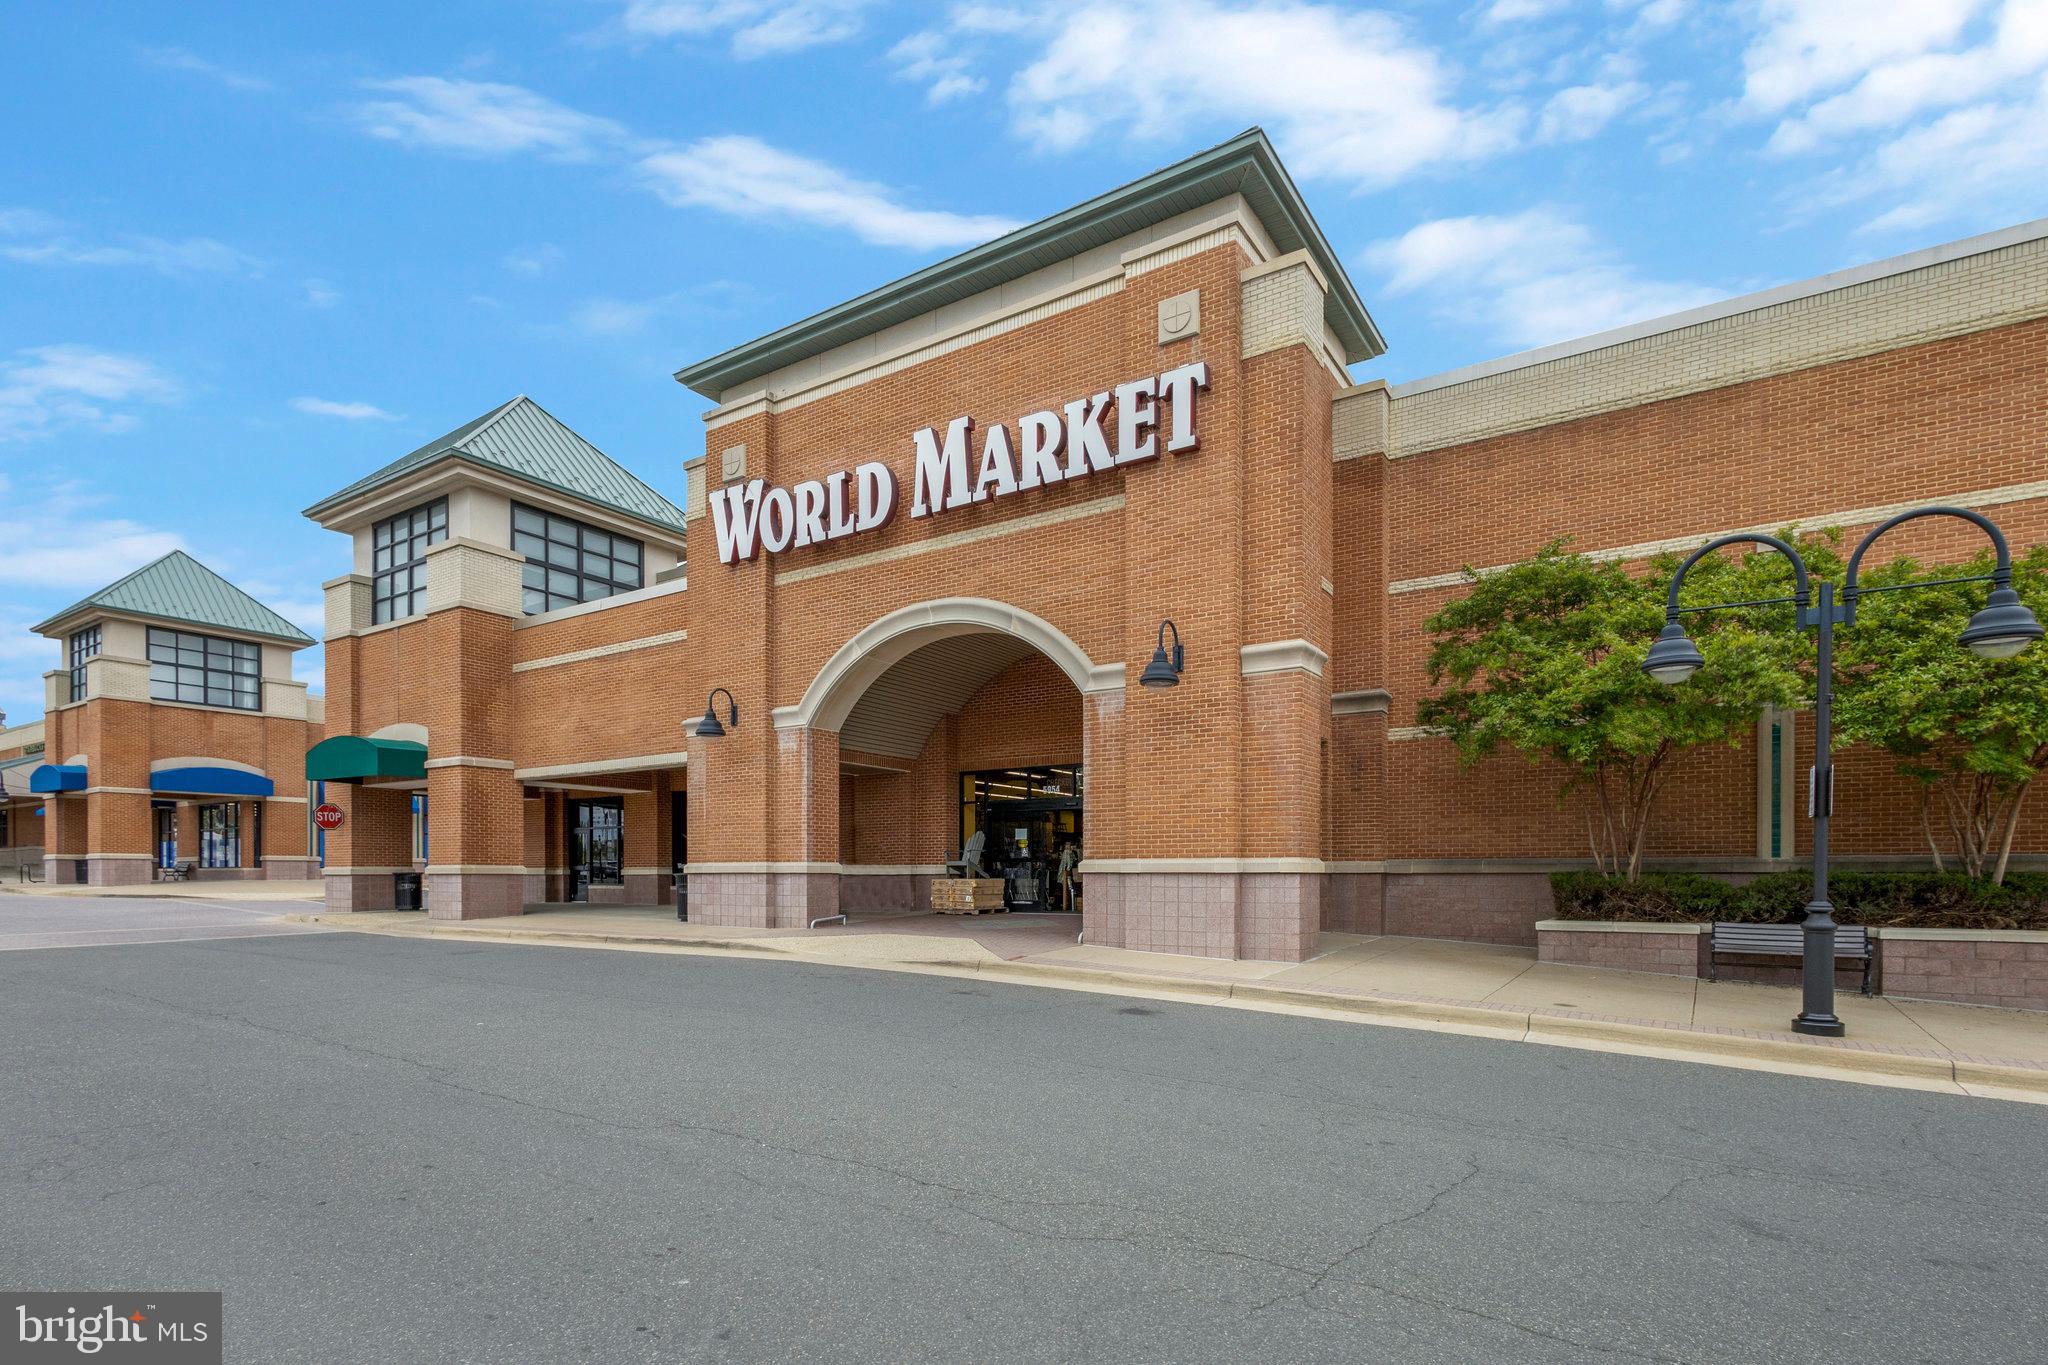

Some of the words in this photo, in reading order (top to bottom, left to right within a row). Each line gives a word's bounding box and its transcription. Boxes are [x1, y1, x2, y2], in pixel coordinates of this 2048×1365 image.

[709, 463, 899, 565] WORLD
[911, 362, 1211, 518] MARKET
[316, 812, 342, 822] STOP
